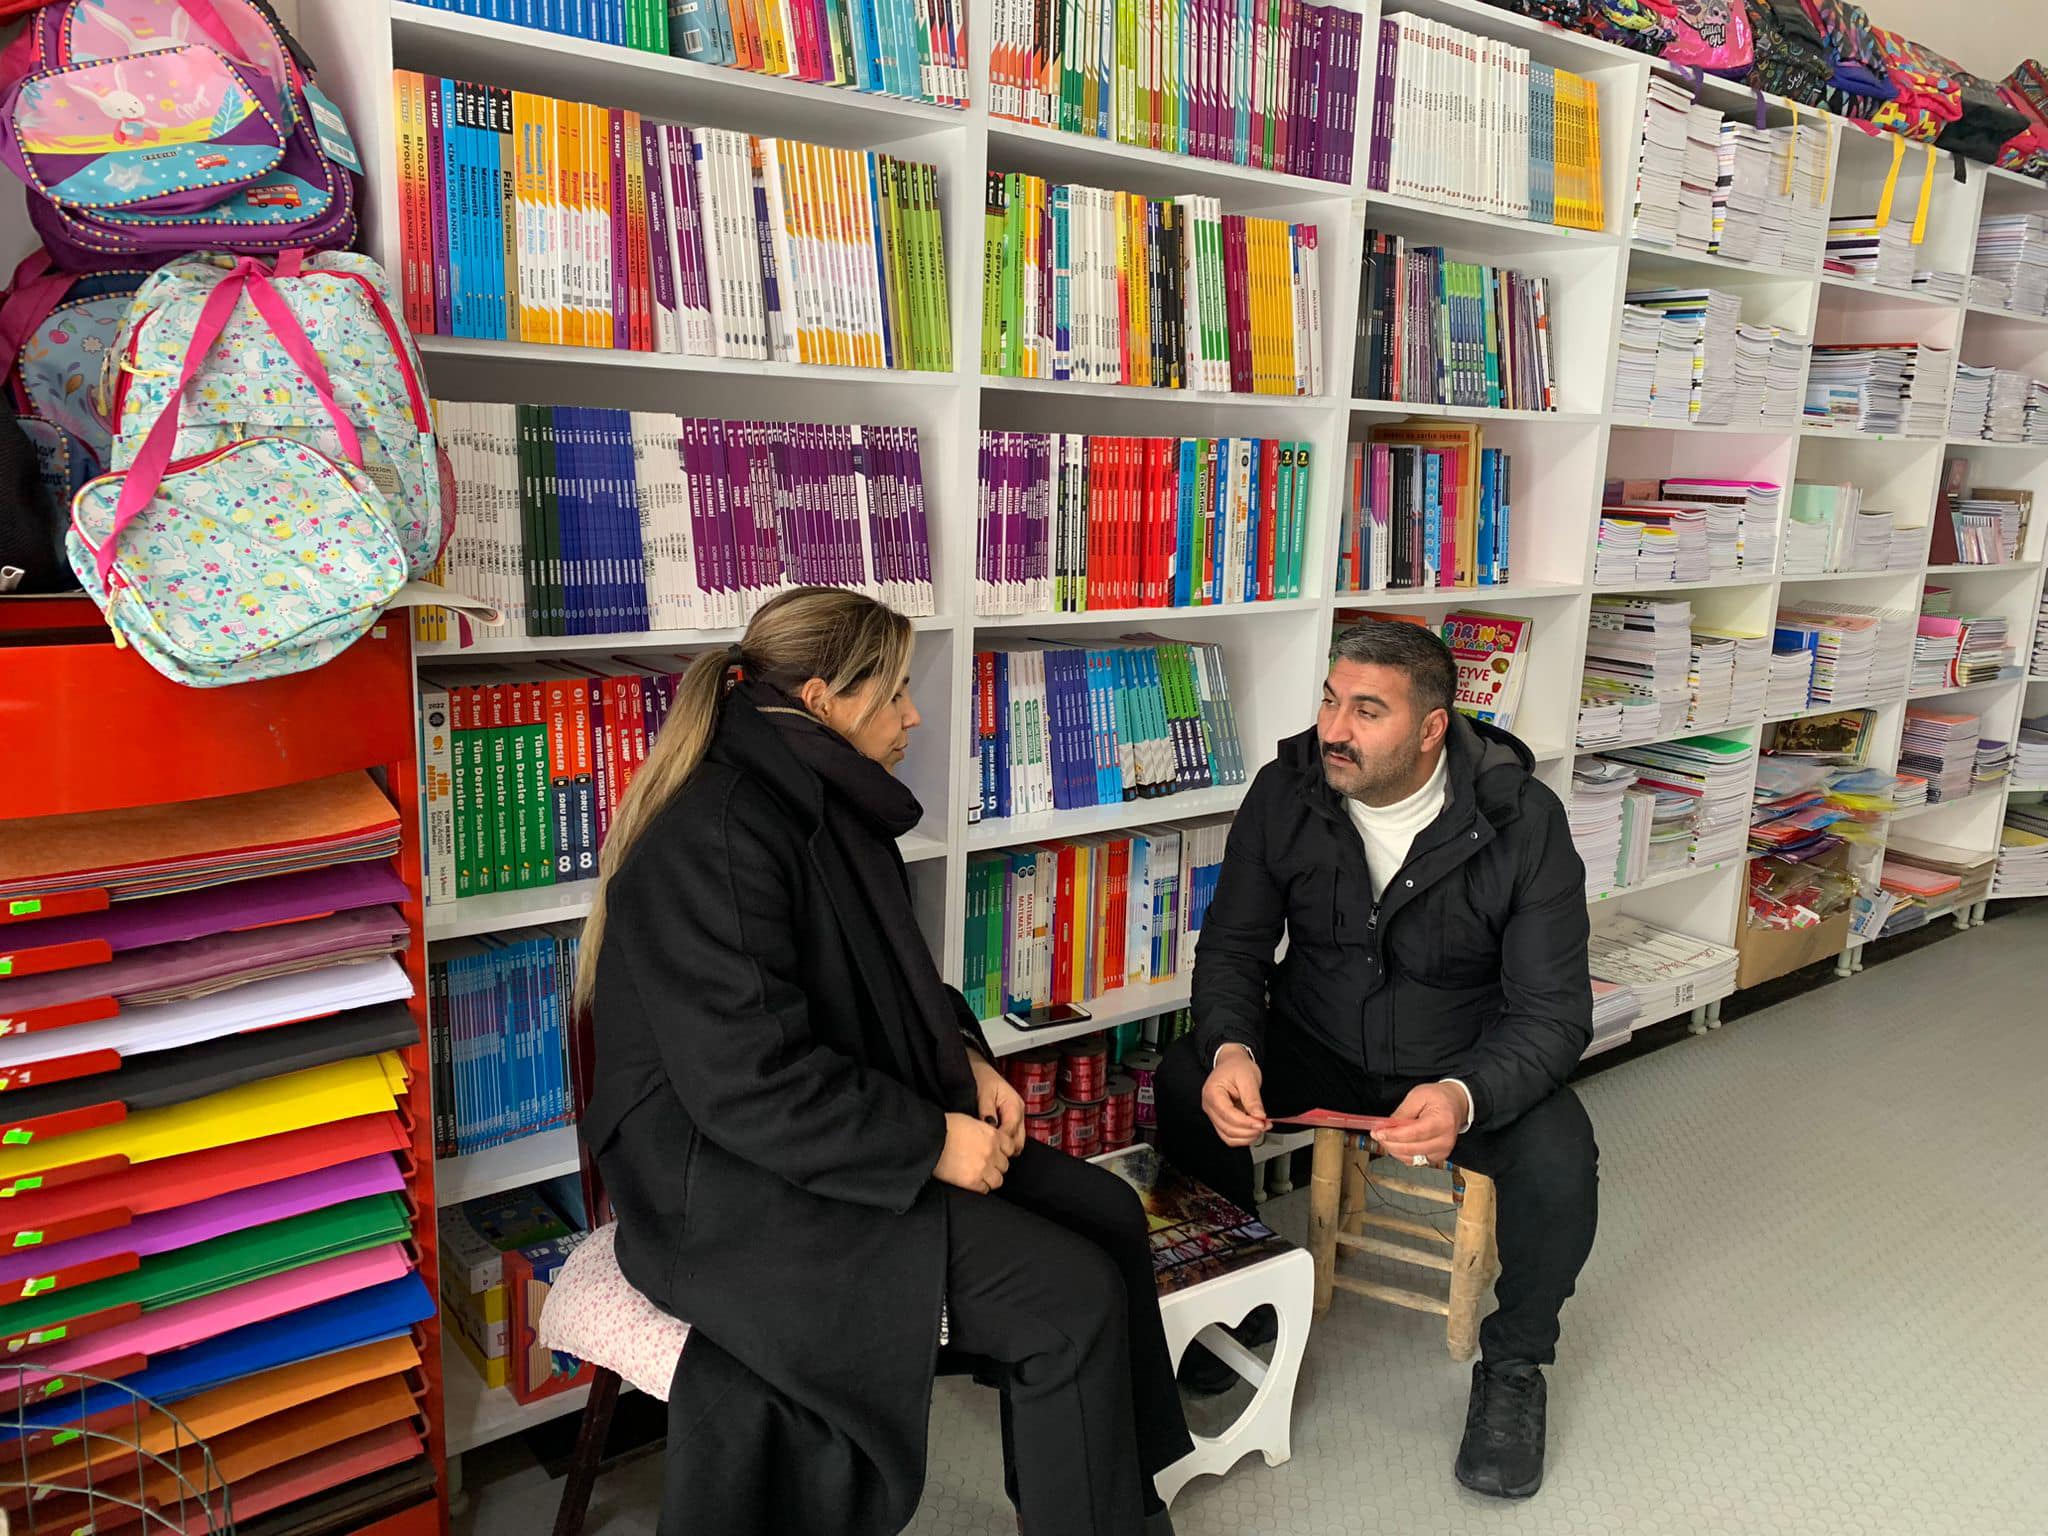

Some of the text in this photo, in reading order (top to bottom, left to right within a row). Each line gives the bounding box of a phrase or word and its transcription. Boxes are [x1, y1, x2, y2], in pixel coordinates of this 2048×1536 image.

[419, 184, 427, 208] SORU
[449, 179, 457, 204] SORU
[504, 170, 513, 200] Fizik
[1198, 490, 1206, 517] Kitap
[453, 695, 461, 704] 8.
[474, 695, 481, 704] 8.
[494, 693, 501, 702] 8.
[513, 692, 520, 701] 8.
[1455, 689, 1494, 706] ZELER
[514, 703, 522, 723] Sınıf
[577, 710, 585, 729] TÜM
[455, 741, 463, 765] Tüm
[474, 739, 483, 764] Tüm
[495, 738, 505, 762] Tüm
[516, 736, 525, 760] Tüm
[578, 730, 586, 768] DERSLER
[622, 738, 631, 761] SINIF
[533, 690, 547, 850] 8. Sınıf Tüm Dersler Soru Bankası
[608, 762, 616, 788] DERSLER
[428, 765, 450, 801] TÜM DERSLER
[456, 769, 465, 811] Dersler
[475, 767, 484, 809] Dersler
[496, 765, 506, 807] Dersler
[517, 763, 526, 805] Dersler
[555, 712, 571, 872] TÜM DERSLER SORU BANKASI 8
[989, 796, 997, 810] 5
[519, 826, 527, 853] Bankası
[582, 813, 590, 847] BANKASI
[581, 852, 593, 869] 8
